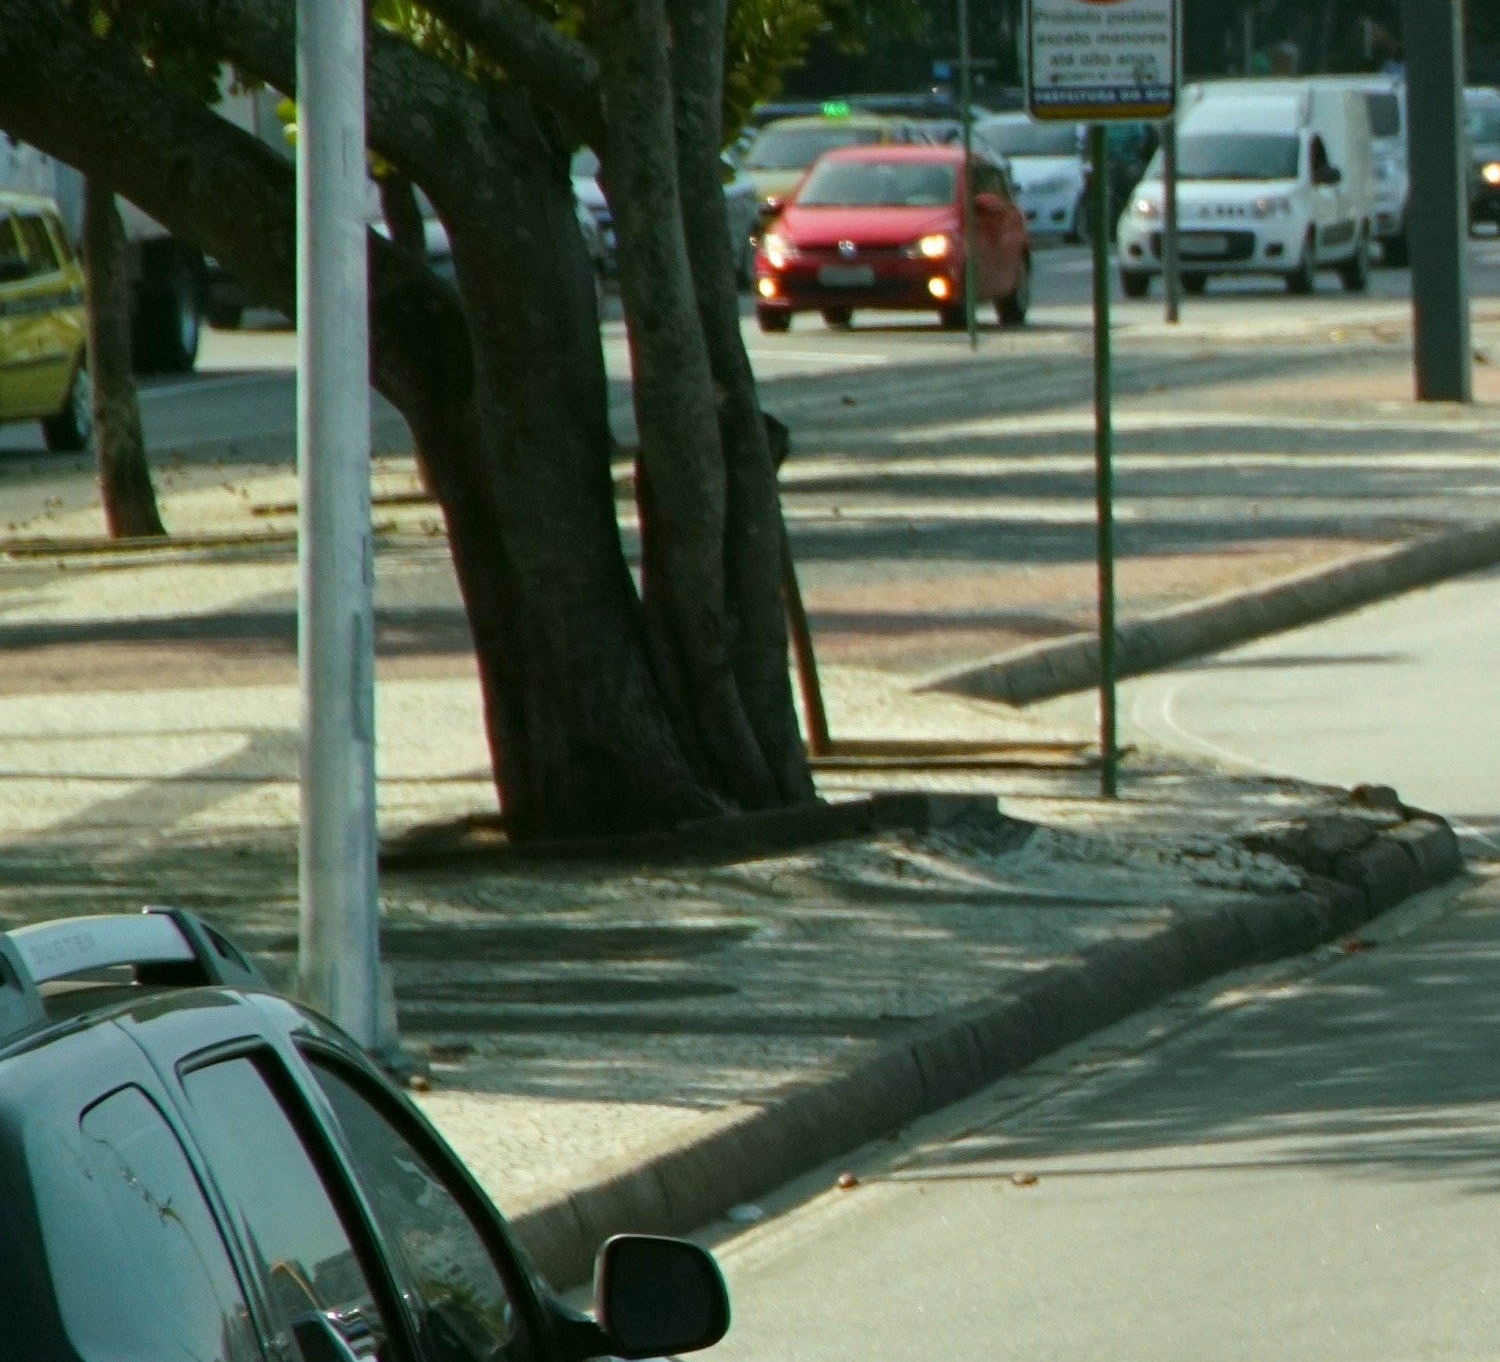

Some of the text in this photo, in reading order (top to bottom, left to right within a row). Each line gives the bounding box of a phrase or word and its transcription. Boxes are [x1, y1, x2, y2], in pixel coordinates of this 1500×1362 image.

[1034, 11, 1102, 25] Proibido
[1037, 32, 1168, 45] exceto menores
[1050, 52, 1074, 65] até
[1080, 52, 1112, 65] oito
